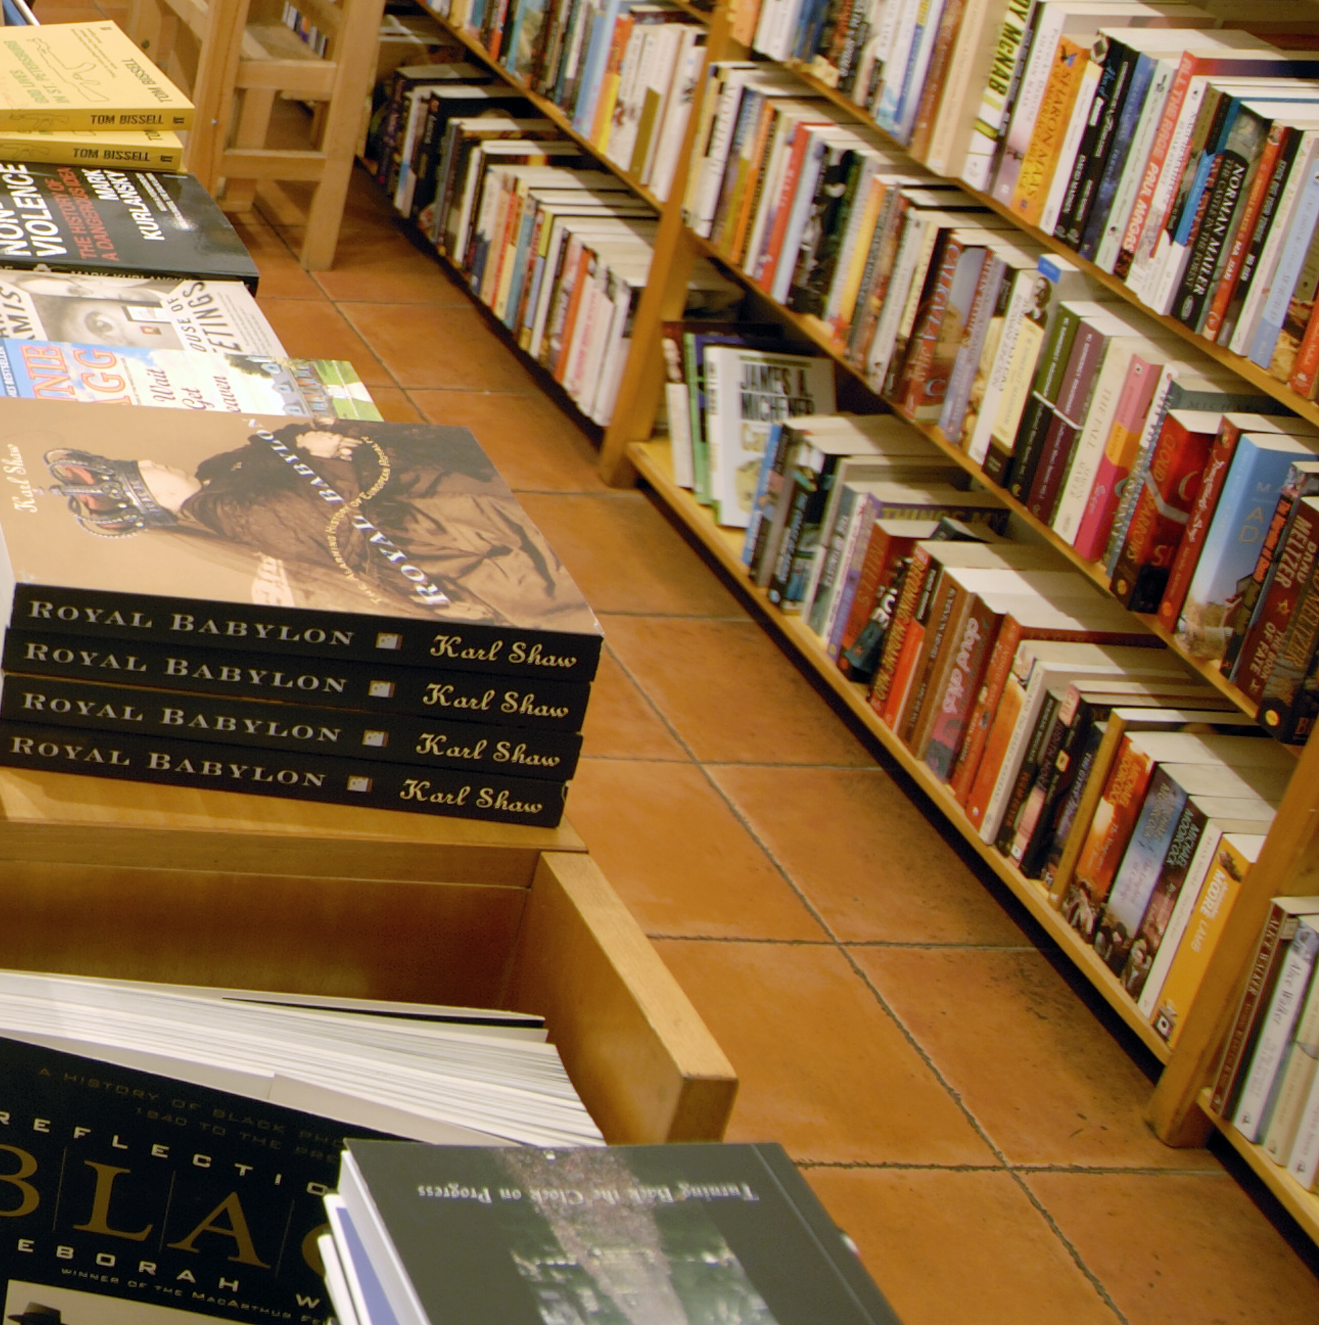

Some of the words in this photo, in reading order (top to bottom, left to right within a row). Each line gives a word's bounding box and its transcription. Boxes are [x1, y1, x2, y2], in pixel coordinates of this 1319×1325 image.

[90, 115, 116, 125] TOM
[119, 114, 164, 125] BISSELL
[72, 148, 100, 159] TOM
[103, 149, 150, 162] BISSELL
[81, 169, 120, 201] MARK
[1216, 162, 1246, 220] NORMAN
[103, 170, 165, 242] KURLANSKY
[1193, 224, 1221, 295] MAILER
[351, 513, 451, 606] ROYAL
[1274, 515, 1312, 588] MELTZER
[30, 600, 153, 628] ROYAL
[169, 614, 355, 646] BABYLON
[430, 634, 498, 662] Karl
[508, 641, 577, 668] Shaw
[24, 643, 147, 671] ROYAL
[165, 657, 348, 694] BABYLON
[423, 684, 492, 711] Karl
[500, 691, 569, 718] Shaw
[10, 737, 130, 766] ROYAL
[148, 753, 326, 787] BABYLON
[400, 778, 469, 806] Karl
[476, 787, 543, 813] Shaw
[1201, 868, 1226, 916] MOORE
[1191, 921, 1212, 953] LAMB
[417, 1182, 492, 1204] Progress
[499, 1186, 522, 1200] on
[530, 1188, 584, 1205] Clock
[630, 1186, 674, 1203] Back
[679, 1182, 759, 1201] Turning
